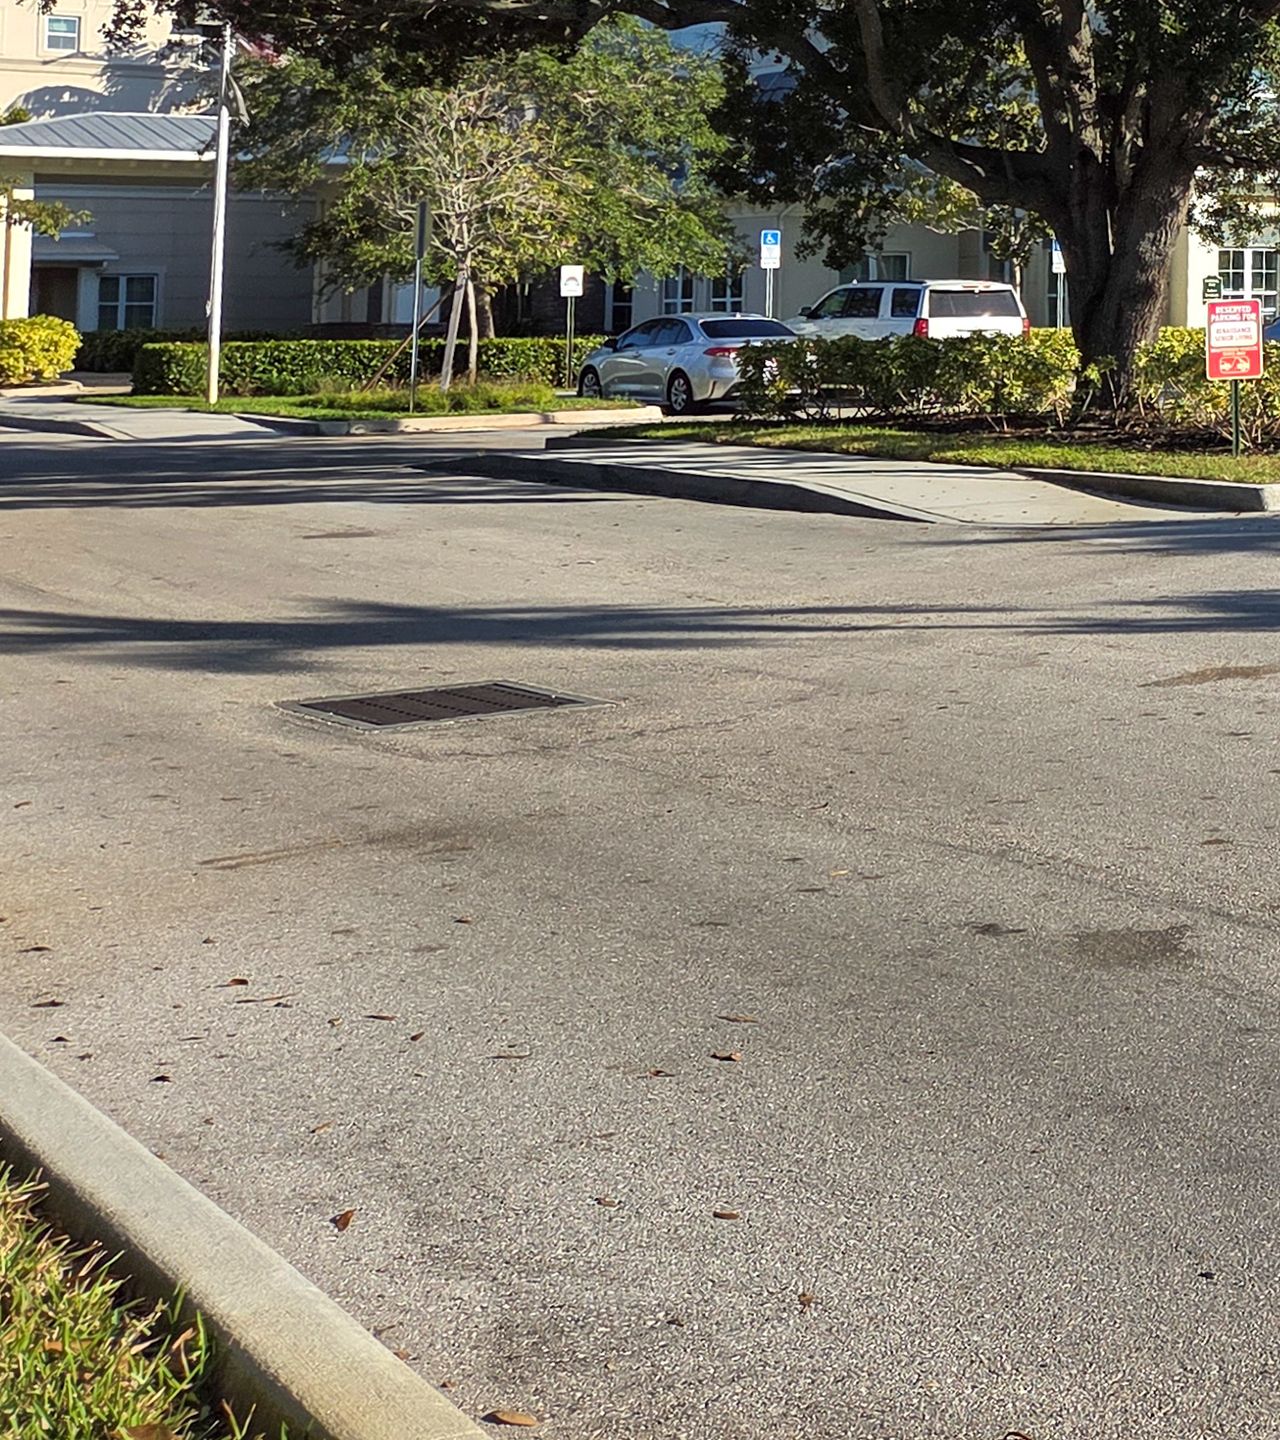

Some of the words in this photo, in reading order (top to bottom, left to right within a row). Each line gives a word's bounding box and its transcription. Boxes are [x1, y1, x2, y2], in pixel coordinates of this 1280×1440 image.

[1215, 306, 1252, 314] RESERVED
[1211, 313, 1241, 322] PARKING
[1242, 312, 1257, 321] FOR
